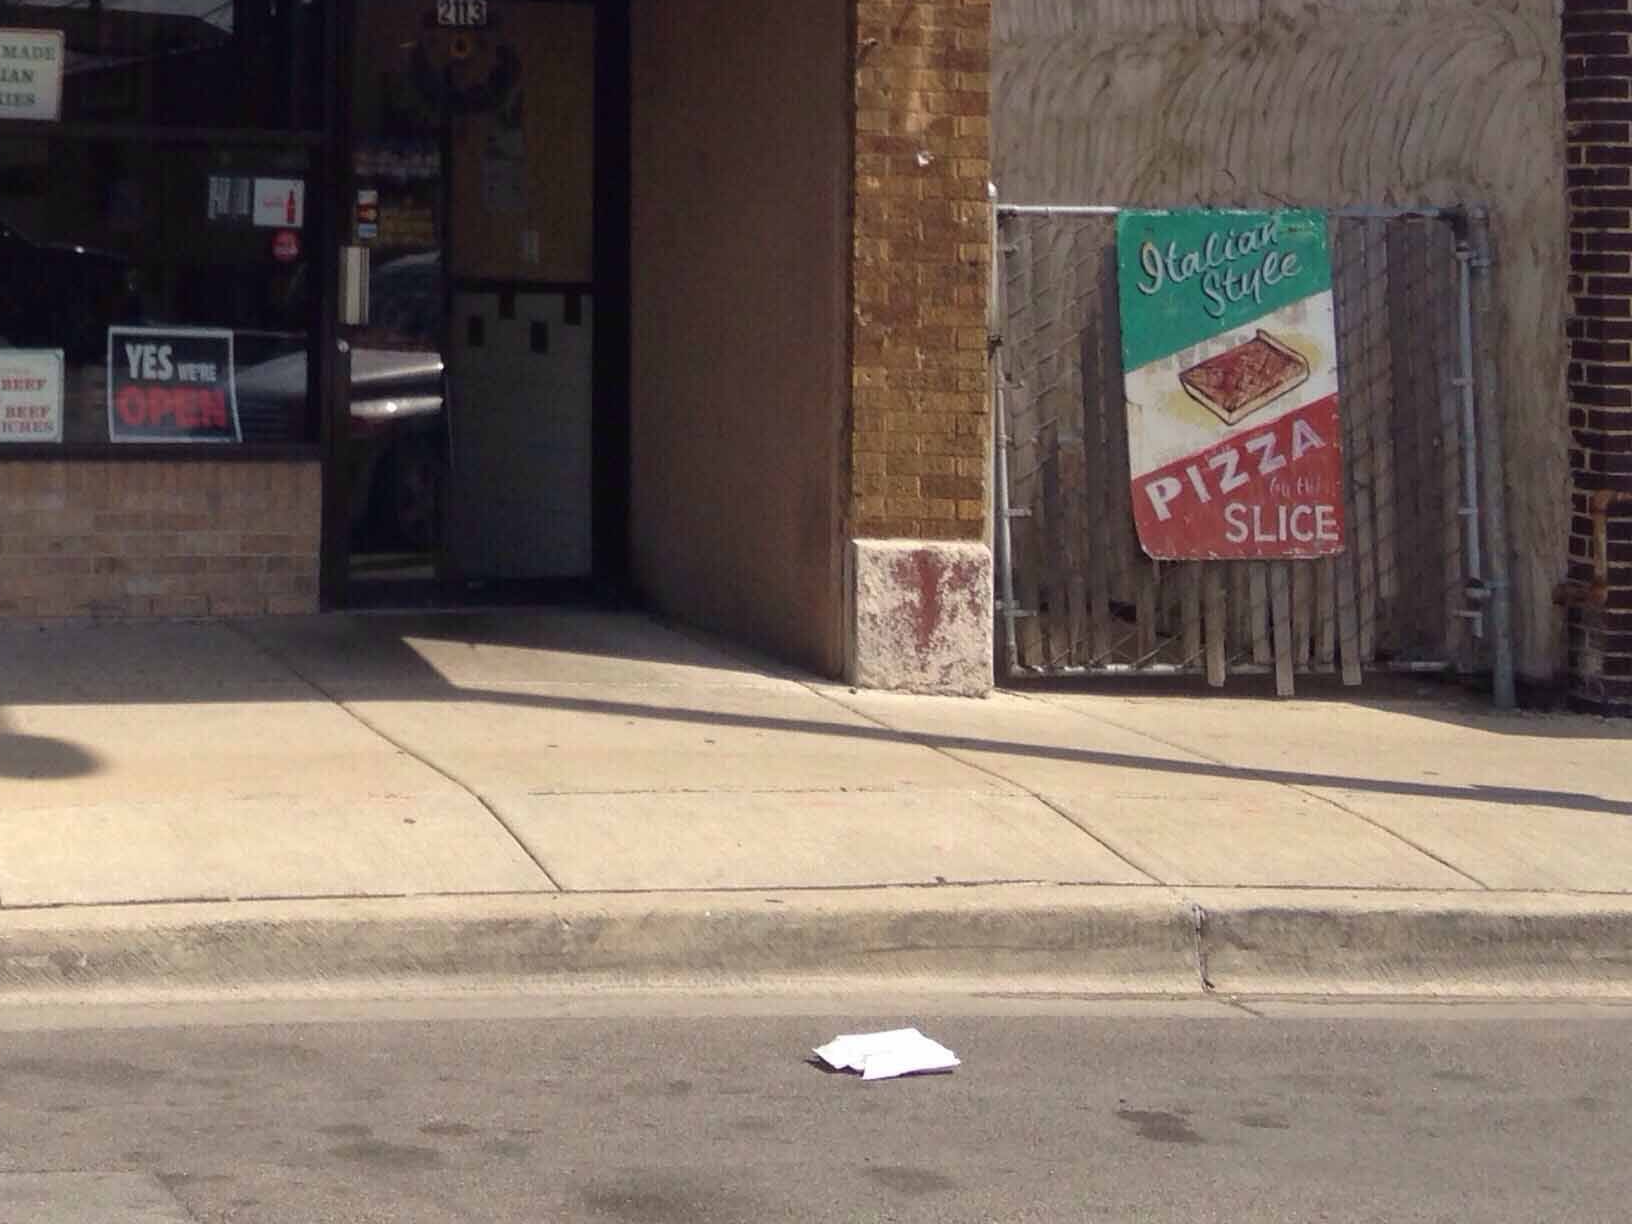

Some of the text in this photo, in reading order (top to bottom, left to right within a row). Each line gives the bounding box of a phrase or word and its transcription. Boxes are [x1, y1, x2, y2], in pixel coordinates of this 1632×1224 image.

[1, 44, 57, 61] MADE
[1137, 217, 1280, 295] Italian
[1202, 251, 1302, 318] Style
[1, 376, 48, 391] BEEF
[125, 343, 174, 382] YES
[117, 382, 226, 429] OPEN
[1144, 418, 1327, 521] PIZZA
[1224, 503, 1339, 544] SLICE
